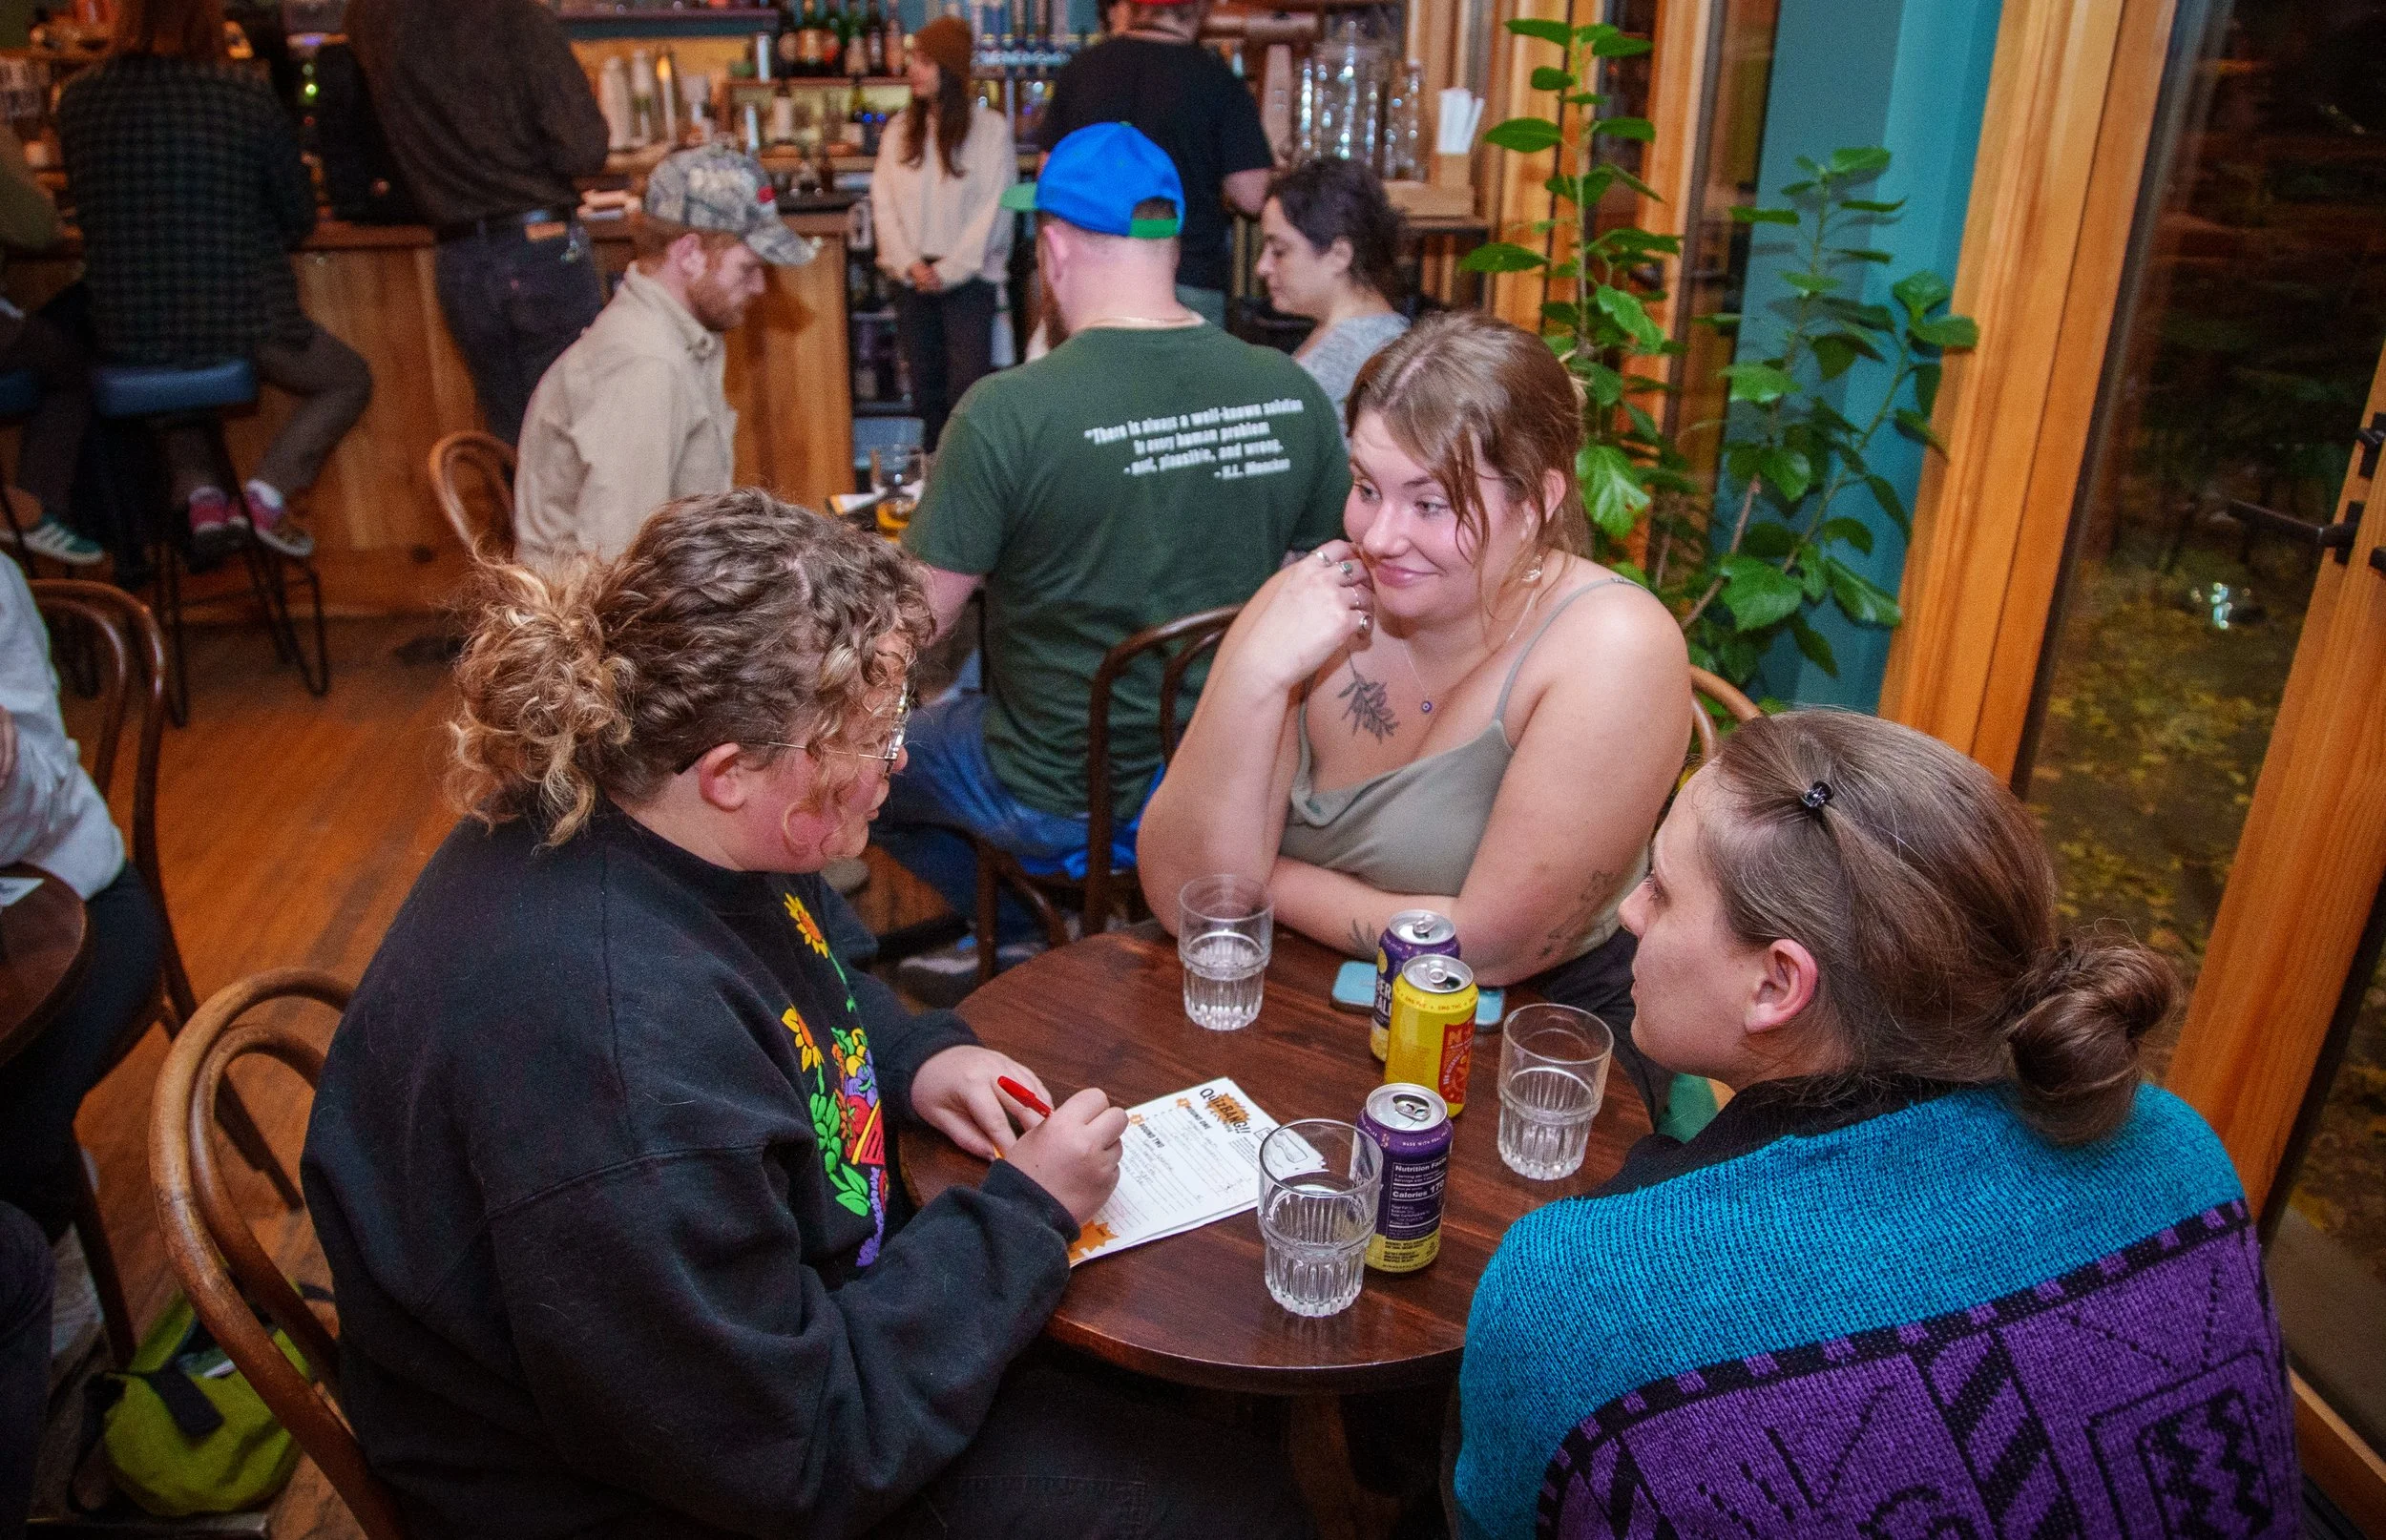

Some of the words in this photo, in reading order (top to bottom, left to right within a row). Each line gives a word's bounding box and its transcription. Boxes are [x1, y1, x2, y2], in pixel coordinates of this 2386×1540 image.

[1394, 1164, 1430, 1174] Nutrition
[1392, 1191, 1428, 1199] Calories
[1430, 1180, 1445, 1193] 170
